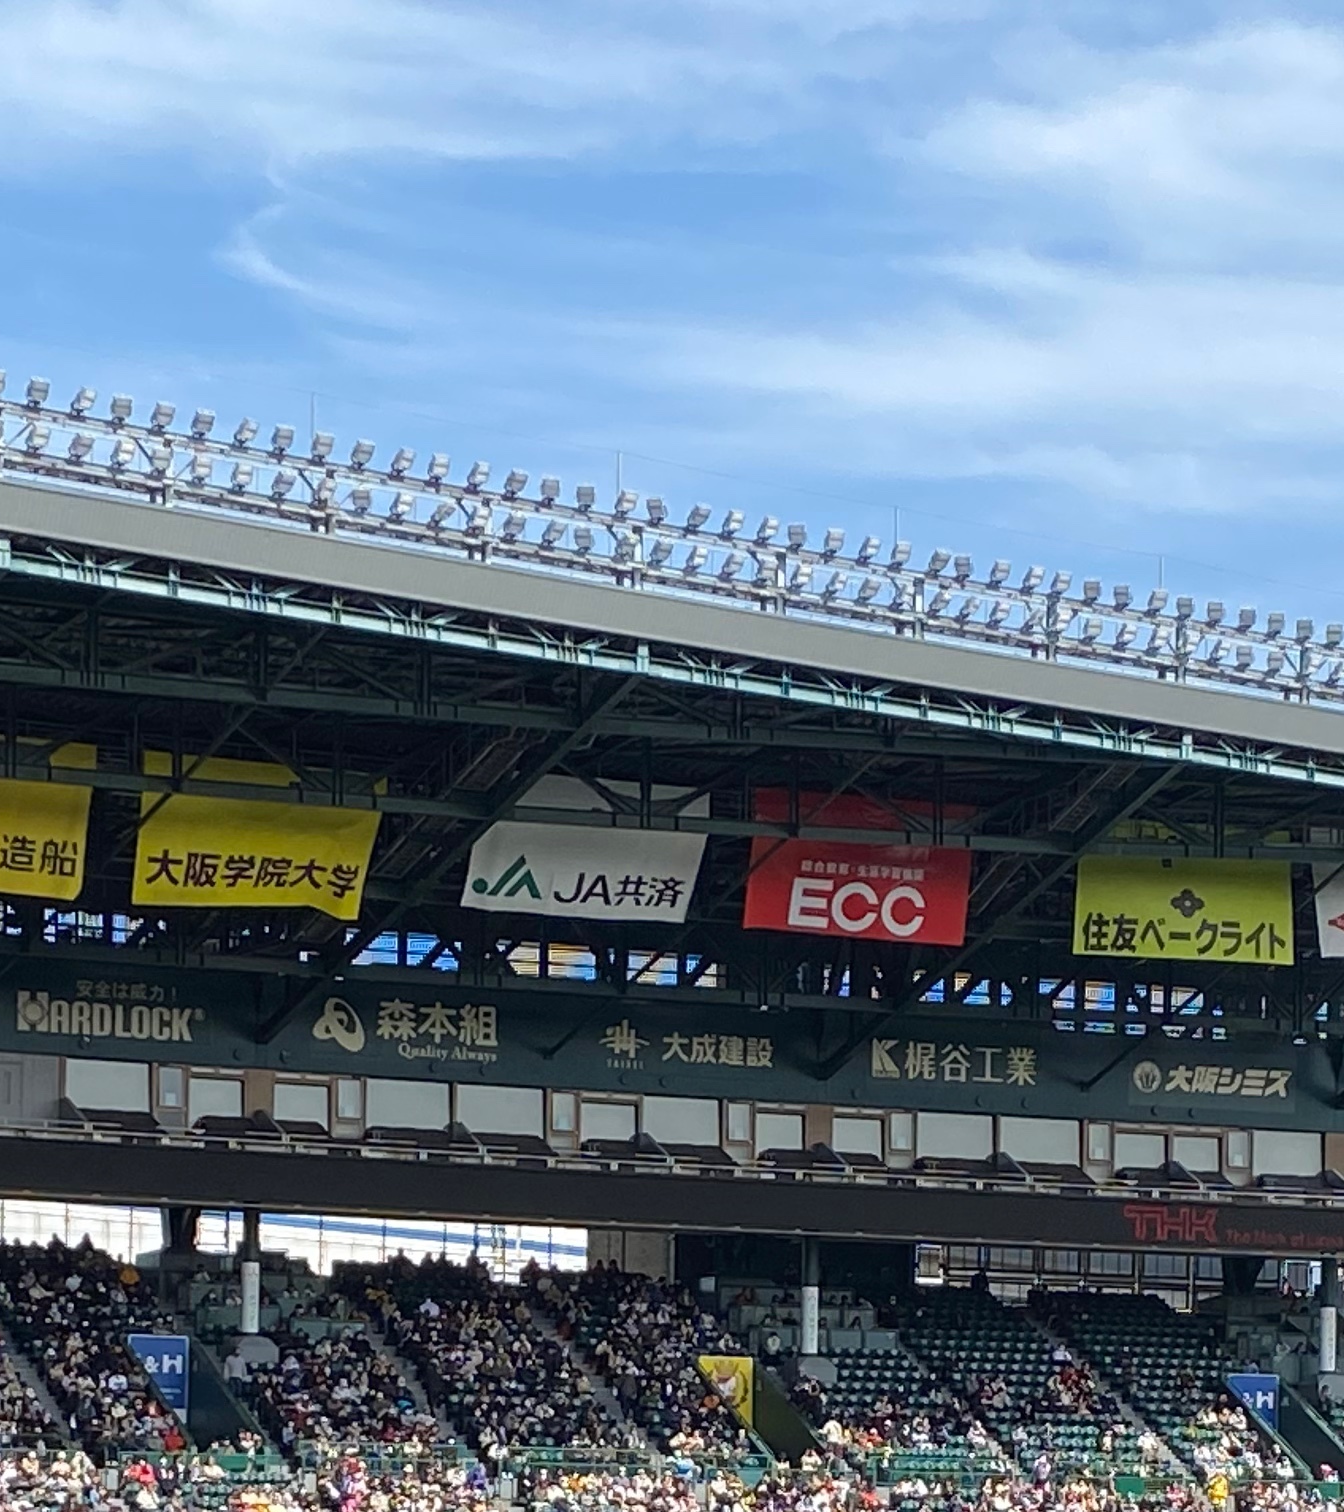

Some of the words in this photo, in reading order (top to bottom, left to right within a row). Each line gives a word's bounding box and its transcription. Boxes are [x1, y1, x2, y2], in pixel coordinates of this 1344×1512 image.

[146, 848, 359, 899] 大阪学院大学
[553, 872, 685, 909] JA共済
[788, 877, 925, 937] ECC
[1082, 912, 1286, 958] 住友ベークライト
[376, 998, 498, 1047] 森本組
[398, 1043, 448, 1062] Quality
[450, 1045, 498, 1063] Always
[663, 1030, 774, 1069] 大成建設
[904, 1040, 1038, 1087] 梶谷工業
[1124, 1203, 1218, 1242] THK
